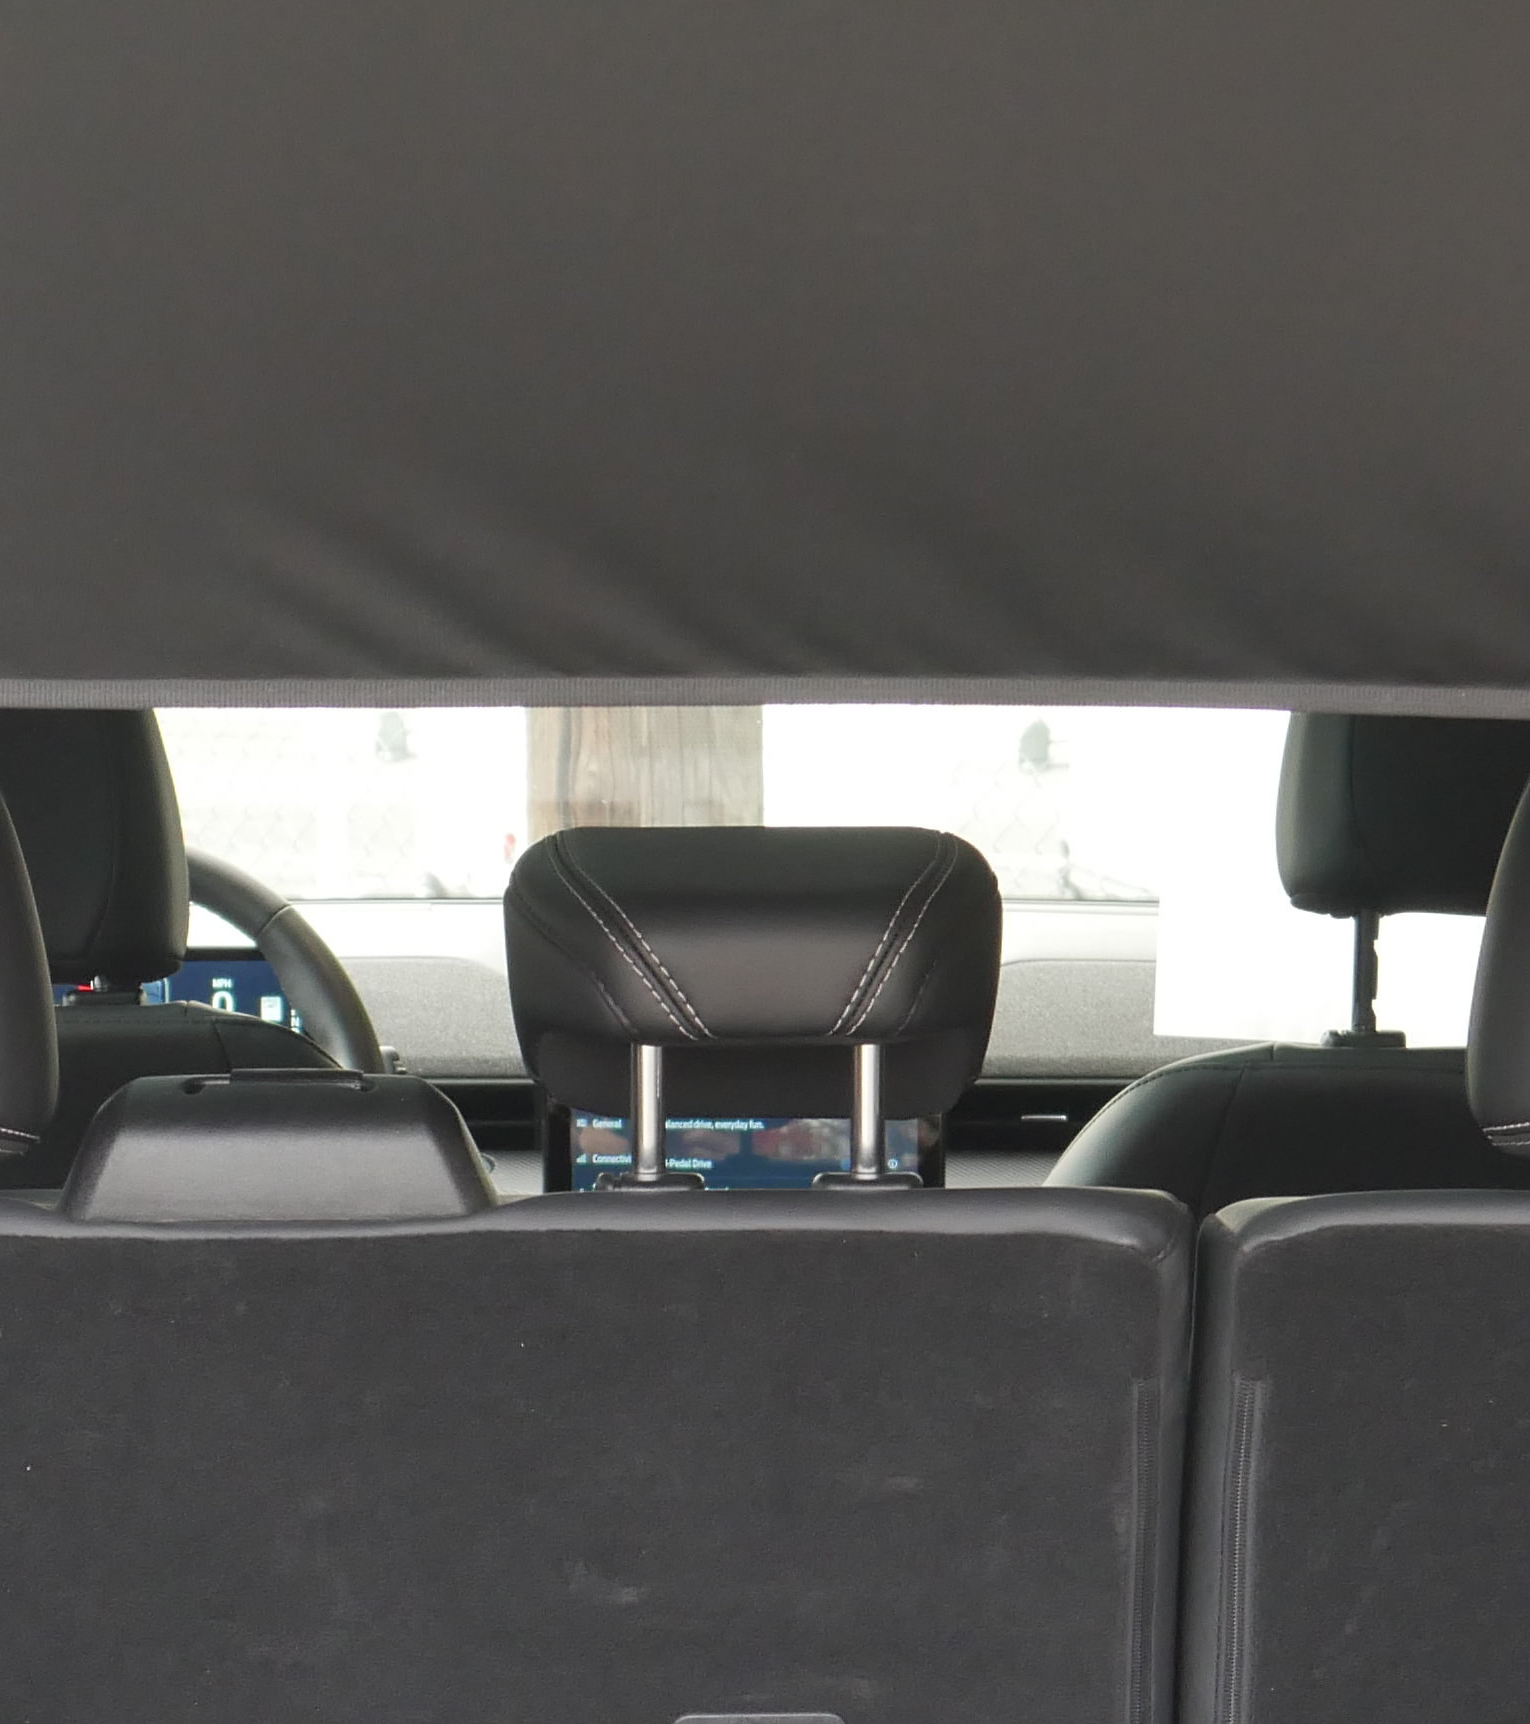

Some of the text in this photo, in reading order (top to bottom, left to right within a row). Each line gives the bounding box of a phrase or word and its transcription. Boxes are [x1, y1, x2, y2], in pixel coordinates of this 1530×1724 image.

[212, 978, 233, 989] MPH
[592, 1118, 622, 1129] General
[693, 1119, 714, 1130] drive,
[715, 1119, 748, 1131] everyday
[592, 1153, 632, 1164] Connectivi
[692, 1156, 712, 1168] Drive
